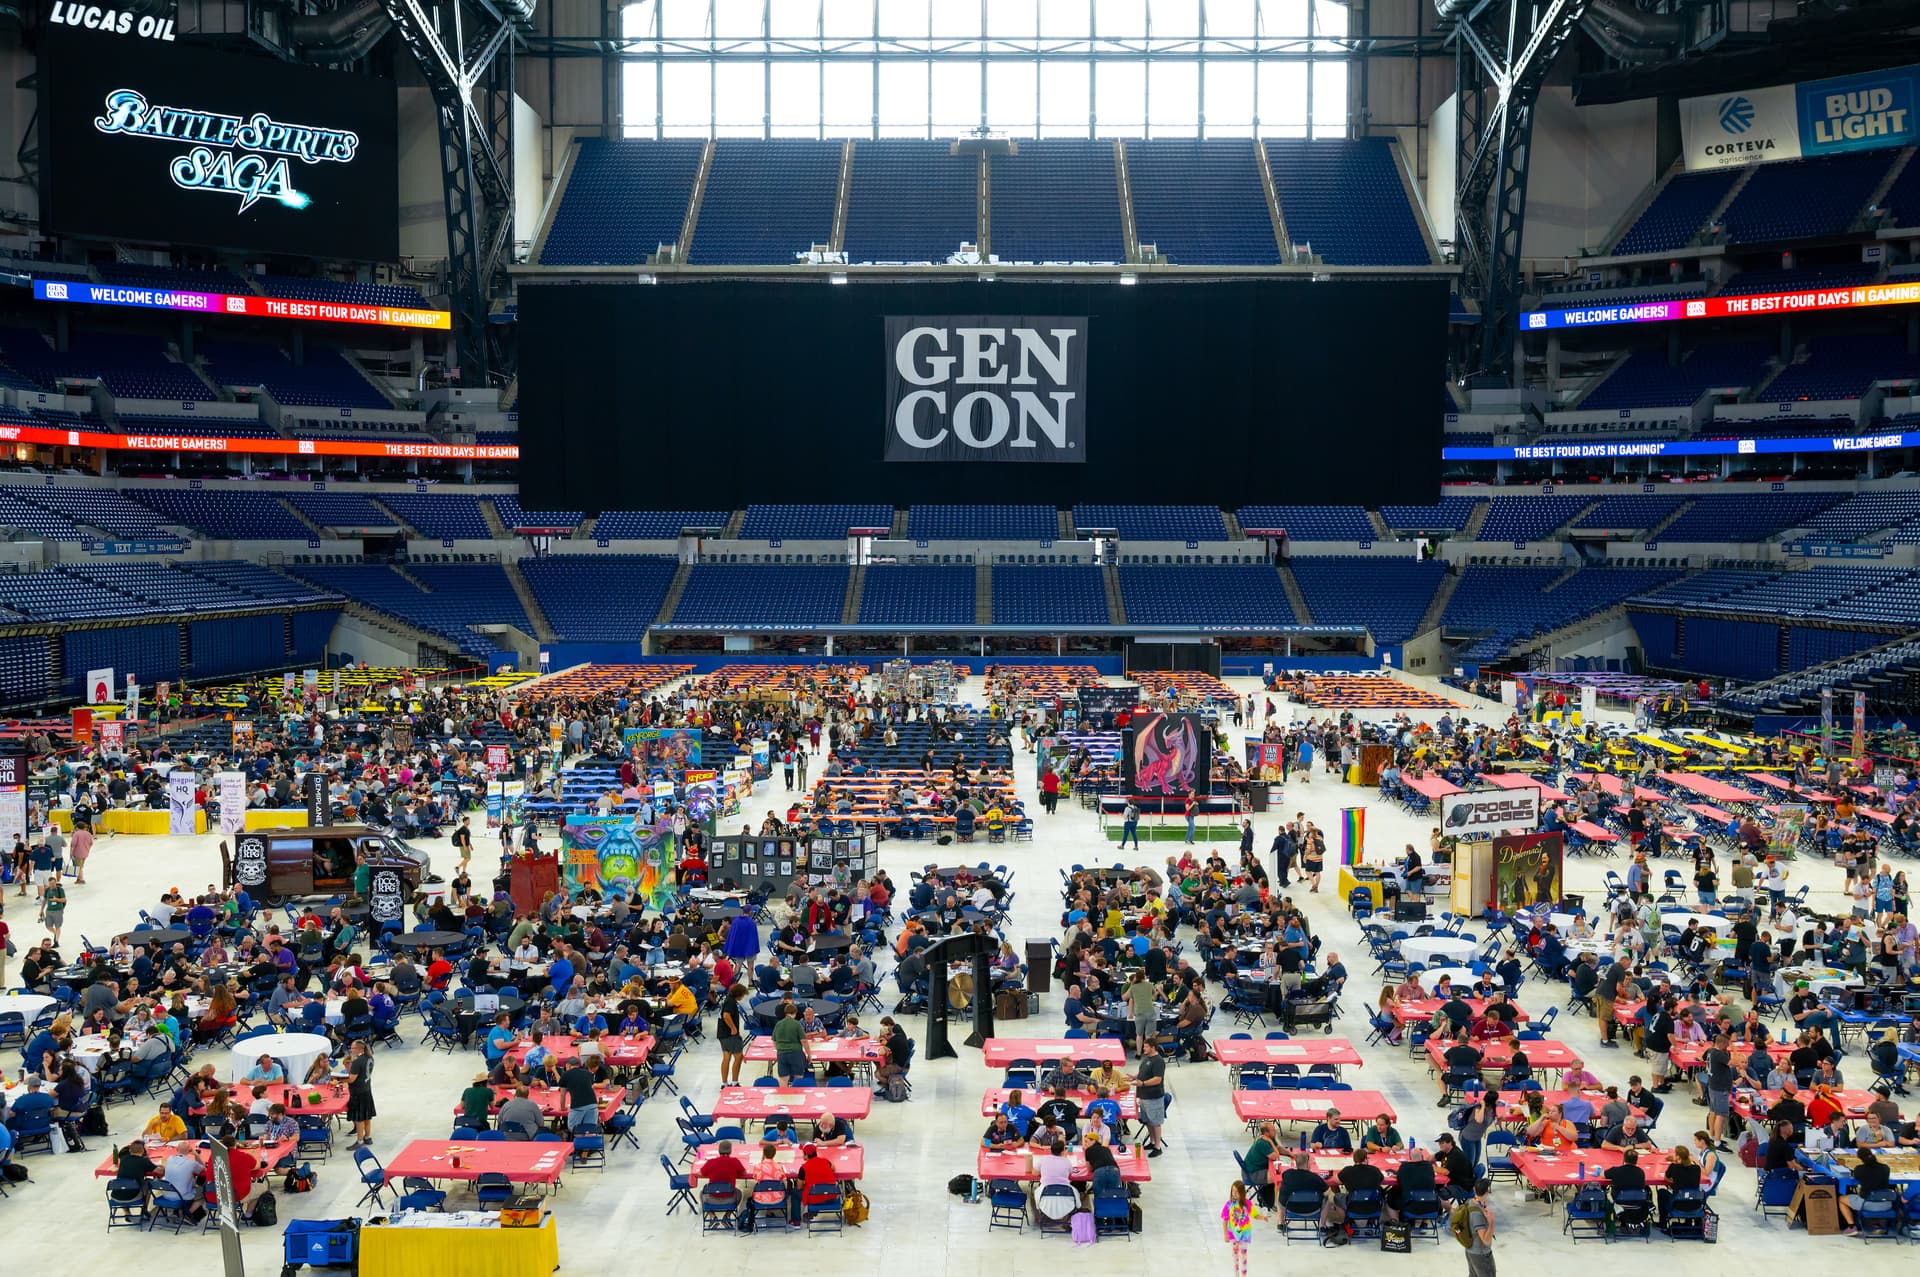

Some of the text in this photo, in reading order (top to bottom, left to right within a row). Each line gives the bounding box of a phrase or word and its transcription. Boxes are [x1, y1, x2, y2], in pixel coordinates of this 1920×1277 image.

[50, 1, 176, 41] LUCAS OIL
[1825, 88, 1892, 119] BUD
[1815, 110, 1907, 143] LIGHT
[1705, 139, 1775, 156] CORTEVA
[1719, 153, 1763, 164] agriscience
[171, 147, 296, 214] SAGA
[47, 284, 66, 292] GEN
[47, 290, 66, 298] CON
[91, 287, 207, 309] WELCOME GAMERS!
[1726, 299, 1749, 312] THE
[1750, 297, 1781, 311] BEST
[1783, 294, 1815, 309] FOUR
[1817, 292, 1850, 306] DAYS
[1852, 290, 1865, 304] IN
[266, 301, 287, 314] THE
[289, 303, 317, 316] BEST
[319, 305, 347, 319] FOUR
[350, 307, 377, 321] DAYS
[379, 309, 390, 322] IN
[1565, 305, 1668, 324] WELCOME GAMERS!
[896, 327, 1077, 386] GEN
[127, 437, 227, 450] WELCOME GAMERS!
[1833, 435, 1902, 450] WELCOME GAMERS!
[385, 444, 403, 455] THE
[405, 445, 427, 456] BEST
[428, 446, 451, 456] FOUR
[452, 446, 474, 457] DAYS
[476, 447, 486, 457] IN
[1514, 447, 1531, 458] THE
[1533, 447, 1554, 457] BEST
[1556, 446, 1580, 457] FOUR
[1582, 446, 1605, 456] DAYS
[1607, 445, 1617, 456] IN
[114, 543, 131, 553] TEXT
[1810, 546, 1827, 555] TEXT
[626, 730, 661, 747] KEYFORGE
[1265, 746, 1277, 754] VAN
[0, 771, 16, 783] HQ
[170, 776, 195, 785] magpie
[688, 771, 715, 785] KEYFORGE
[1878, 777, 1894, 786] HATS
[176, 786, 189, 795] HQ
[1474, 799, 1533, 814] ROGUE
[1468, 810, 1535, 825] JUDGES
[1500, 842, 1544, 869] Diplomacy
[378, 878, 397, 886] DCC
[378, 885, 396, 893] RPG
